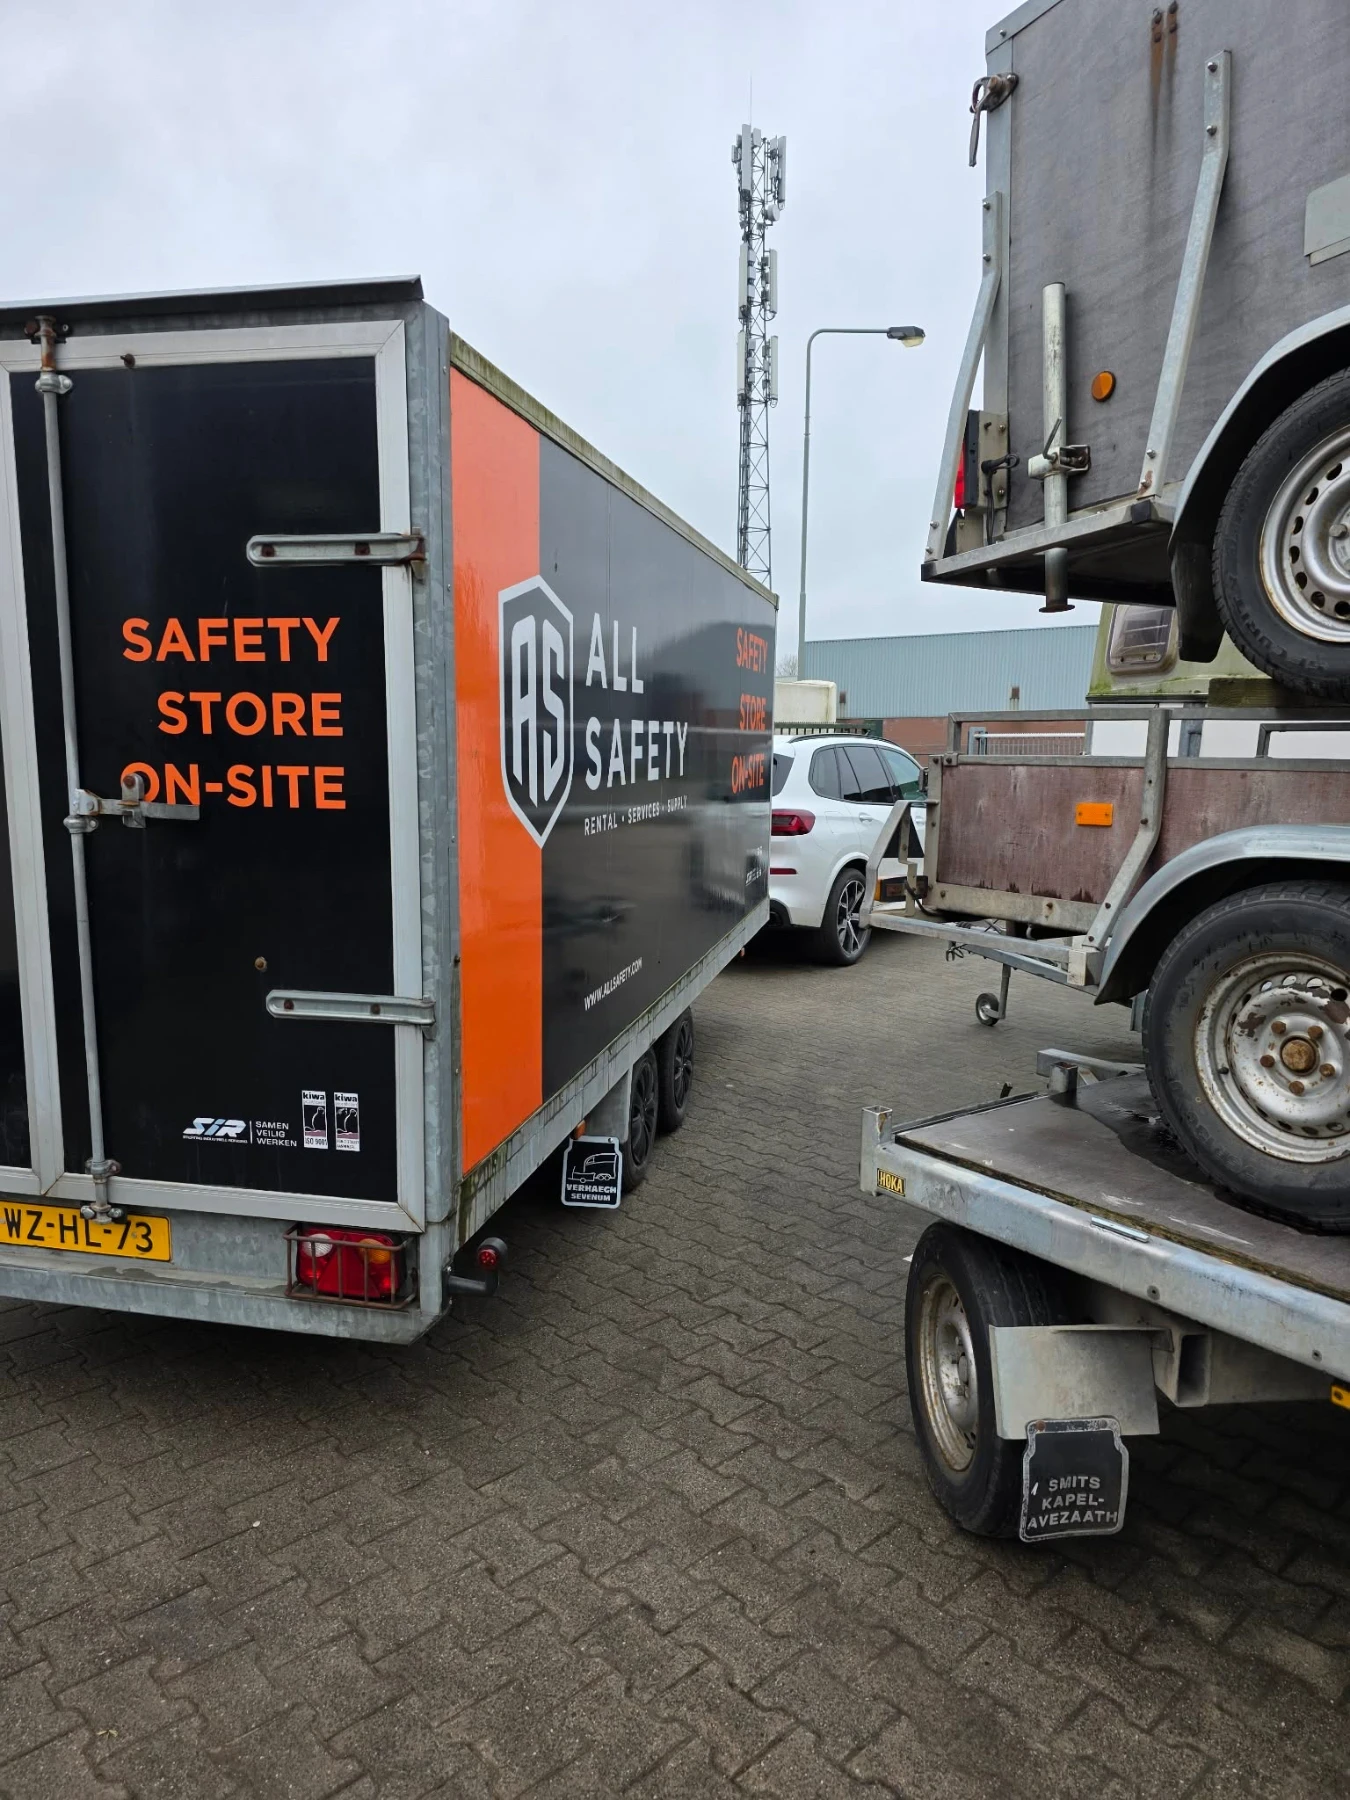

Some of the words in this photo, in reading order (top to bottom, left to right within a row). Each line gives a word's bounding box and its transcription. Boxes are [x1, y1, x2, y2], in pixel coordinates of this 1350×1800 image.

[122, 617, 341, 662] SAFETY
[586, 612, 644, 694] ALL
[736, 627, 769, 674] SAFETY
[157, 691, 344, 737] STORE
[739, 693, 767, 732] STORE
[585, 716, 688, 791] SAFETY
[120, 762, 347, 810] ON-SITE
[731, 753, 766, 794] ON-SITE
[584, 812, 618, 836] RENTAL
[627, 801, 660, 824] SERVICES
[667, 794, 688, 813] SUPPLY
[584, 957, 643, 1011] WWW.ALLSAFETY.COM
[302, 1091, 325, 1101] kiwa
[335, 1093, 358, 1103] kiwa
[255, 1120, 289, 1130] SAMEN
[256, 1129, 286, 1138] VEILIG
[256, 1137, 297, 1147] WERKEN
[566, 1183, 617, 1194] VERHAEGH
[570, 1192, 611, 1202] SEVENUM
[879, 1171, 903, 1193] HOKA
[4, 1207, 153, 1253] WZ-HL-73
[1048, 1475, 1101, 1492] SMITS
[1041, 1493, 1105, 1511] KAPEL-
[1027, 1510, 1118, 1530] AVEZAATH
